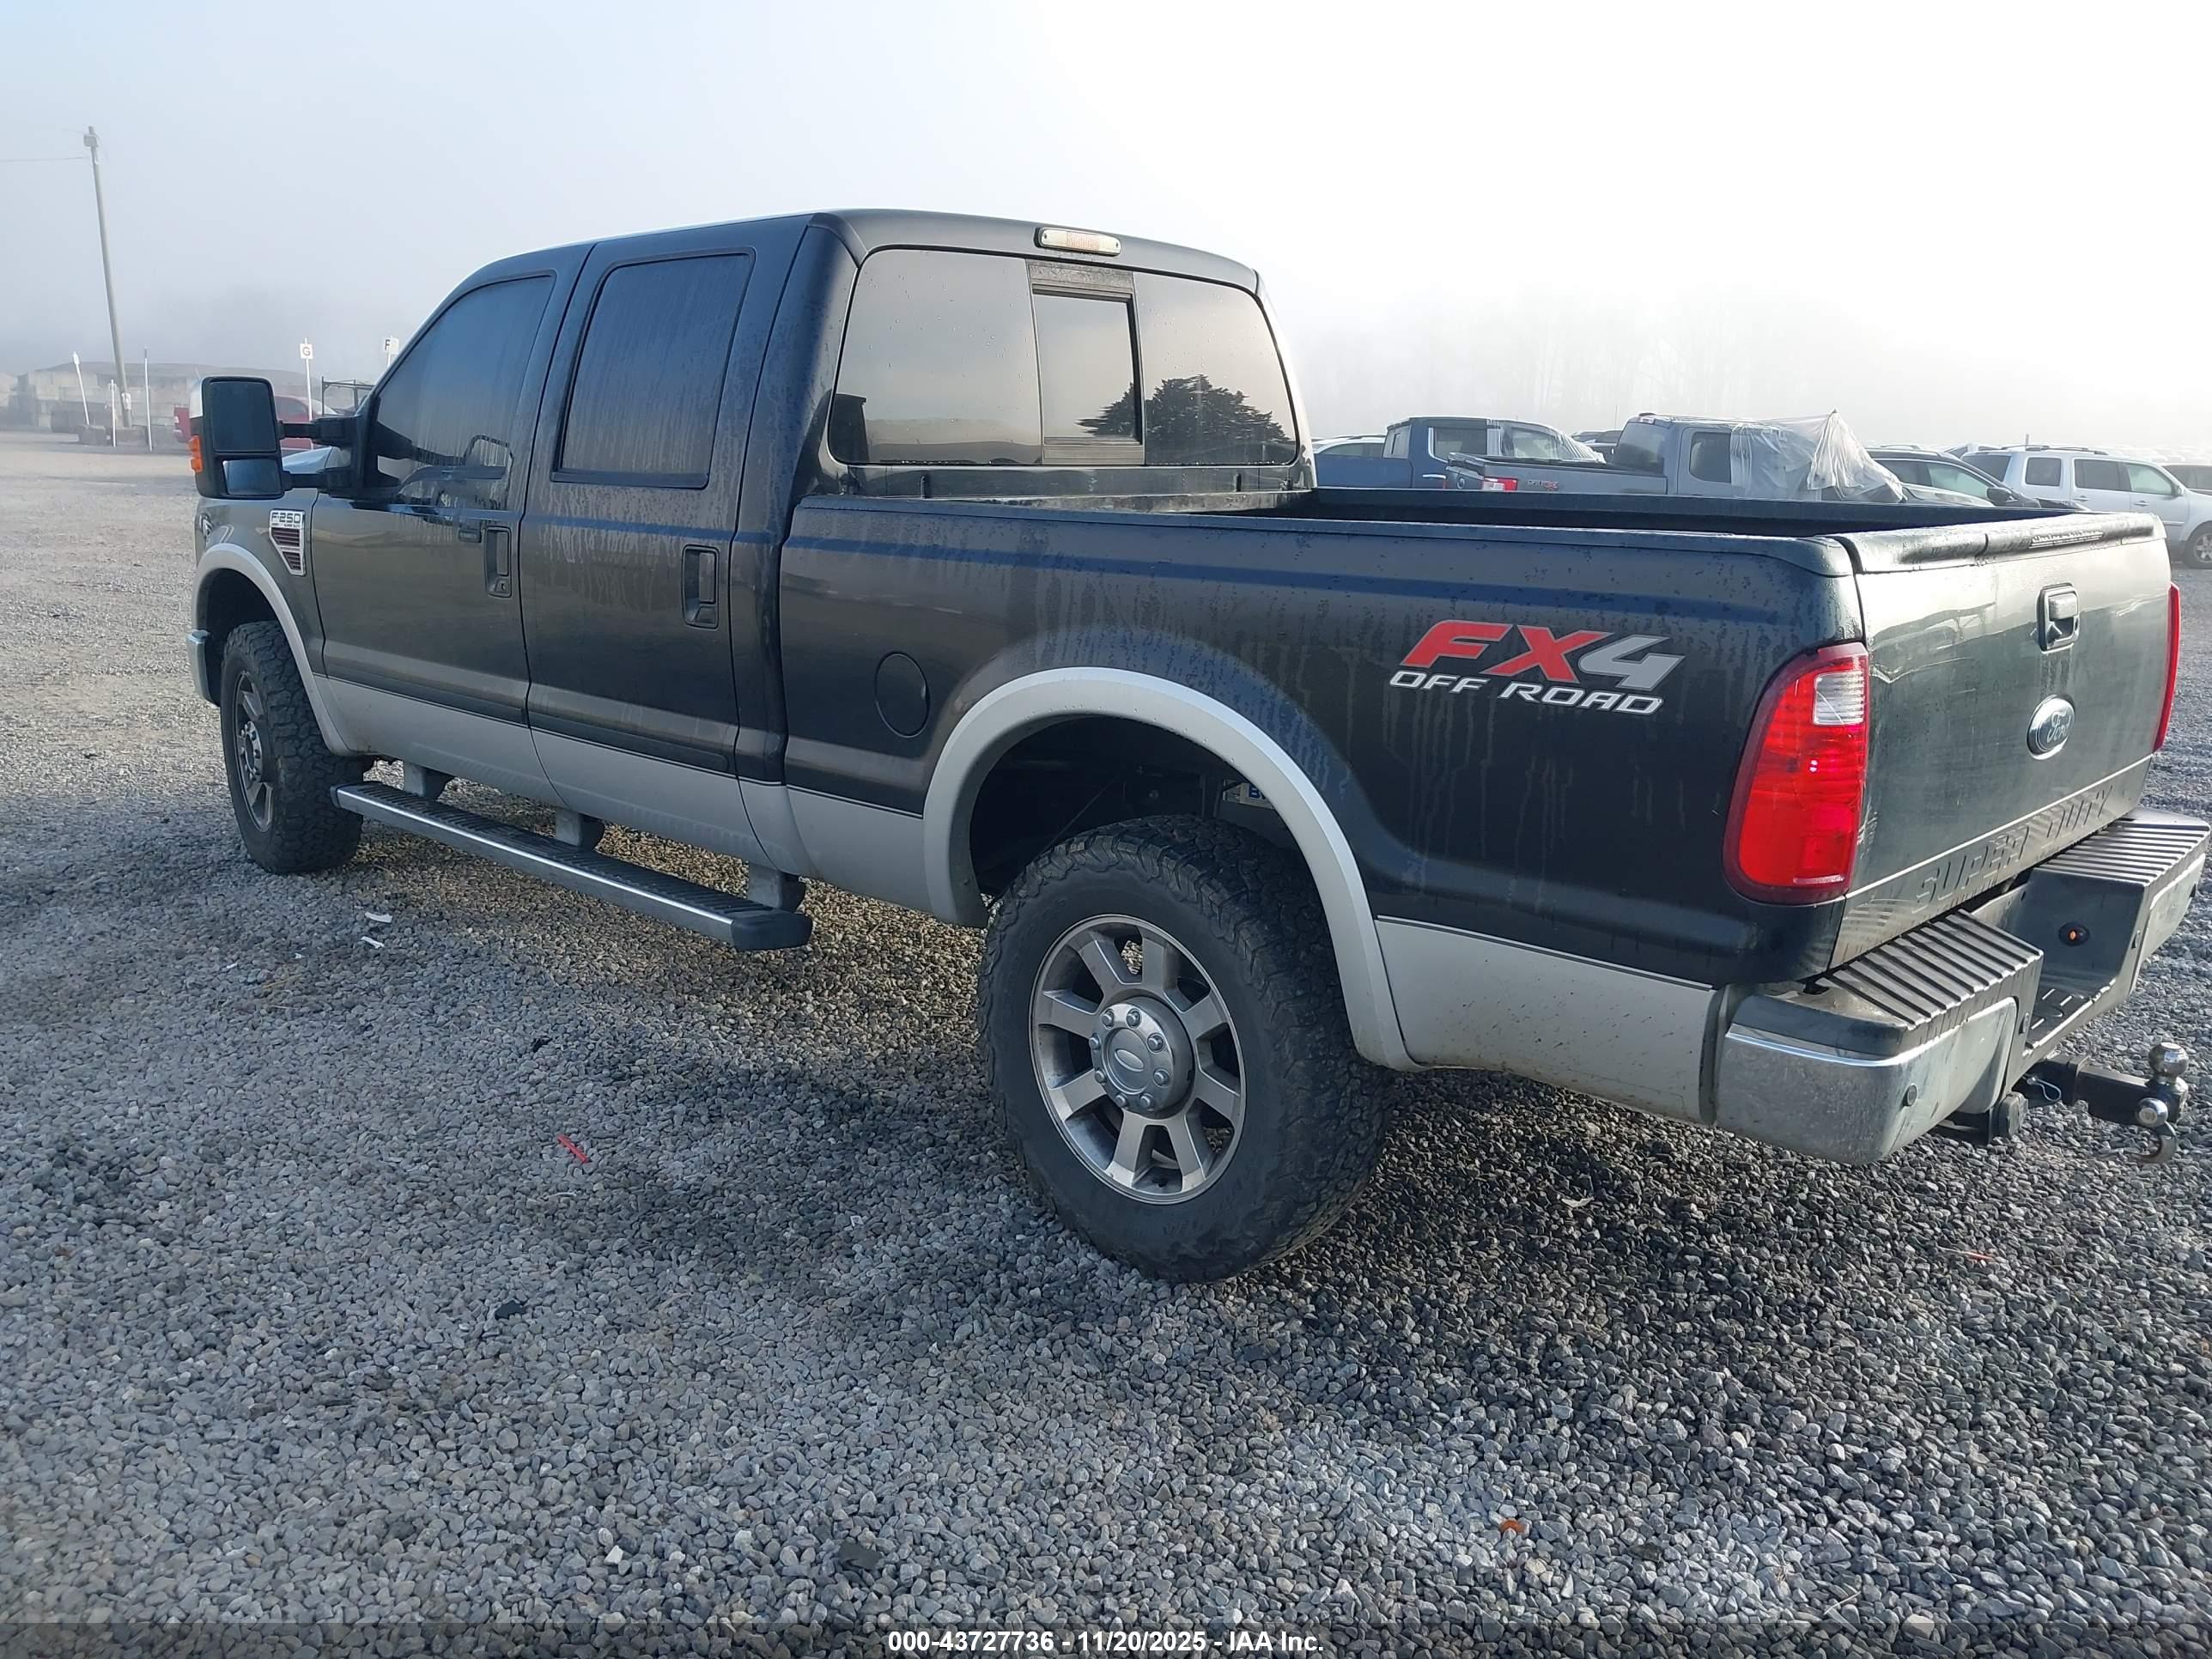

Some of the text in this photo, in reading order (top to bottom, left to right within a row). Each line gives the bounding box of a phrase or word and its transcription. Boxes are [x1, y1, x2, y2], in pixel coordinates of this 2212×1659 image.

[302, 347, 311, 356] G
[1400, 619, 1685, 691] FX4
[1389, 670, 1664, 715] OFF ROAD
[2046, 710, 2071, 744] Ford
[1911, 784, 2113, 915] SUPER DUTY
